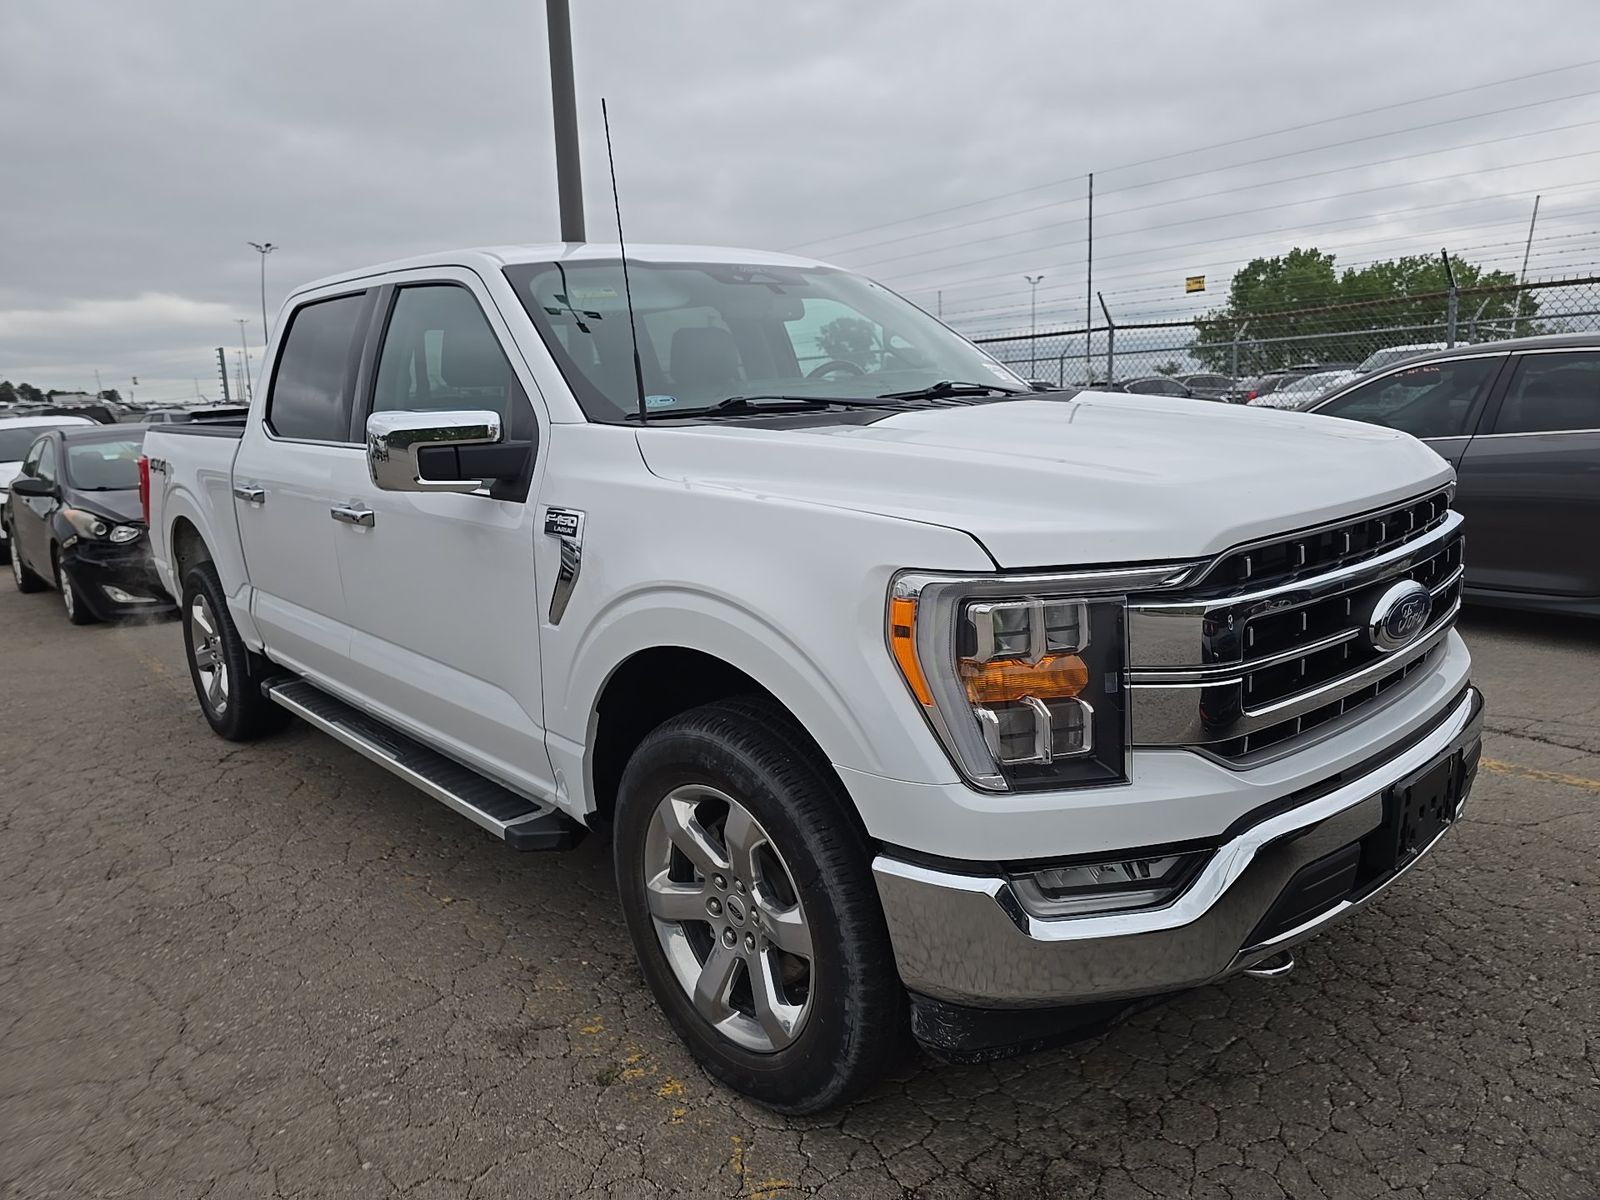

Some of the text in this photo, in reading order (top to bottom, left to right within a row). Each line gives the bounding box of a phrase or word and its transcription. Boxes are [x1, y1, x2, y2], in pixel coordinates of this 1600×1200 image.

[546, 513, 578, 527] F-150
[553, 525, 574, 534] LARIAT
[1398, 599, 1426, 633] Ford
